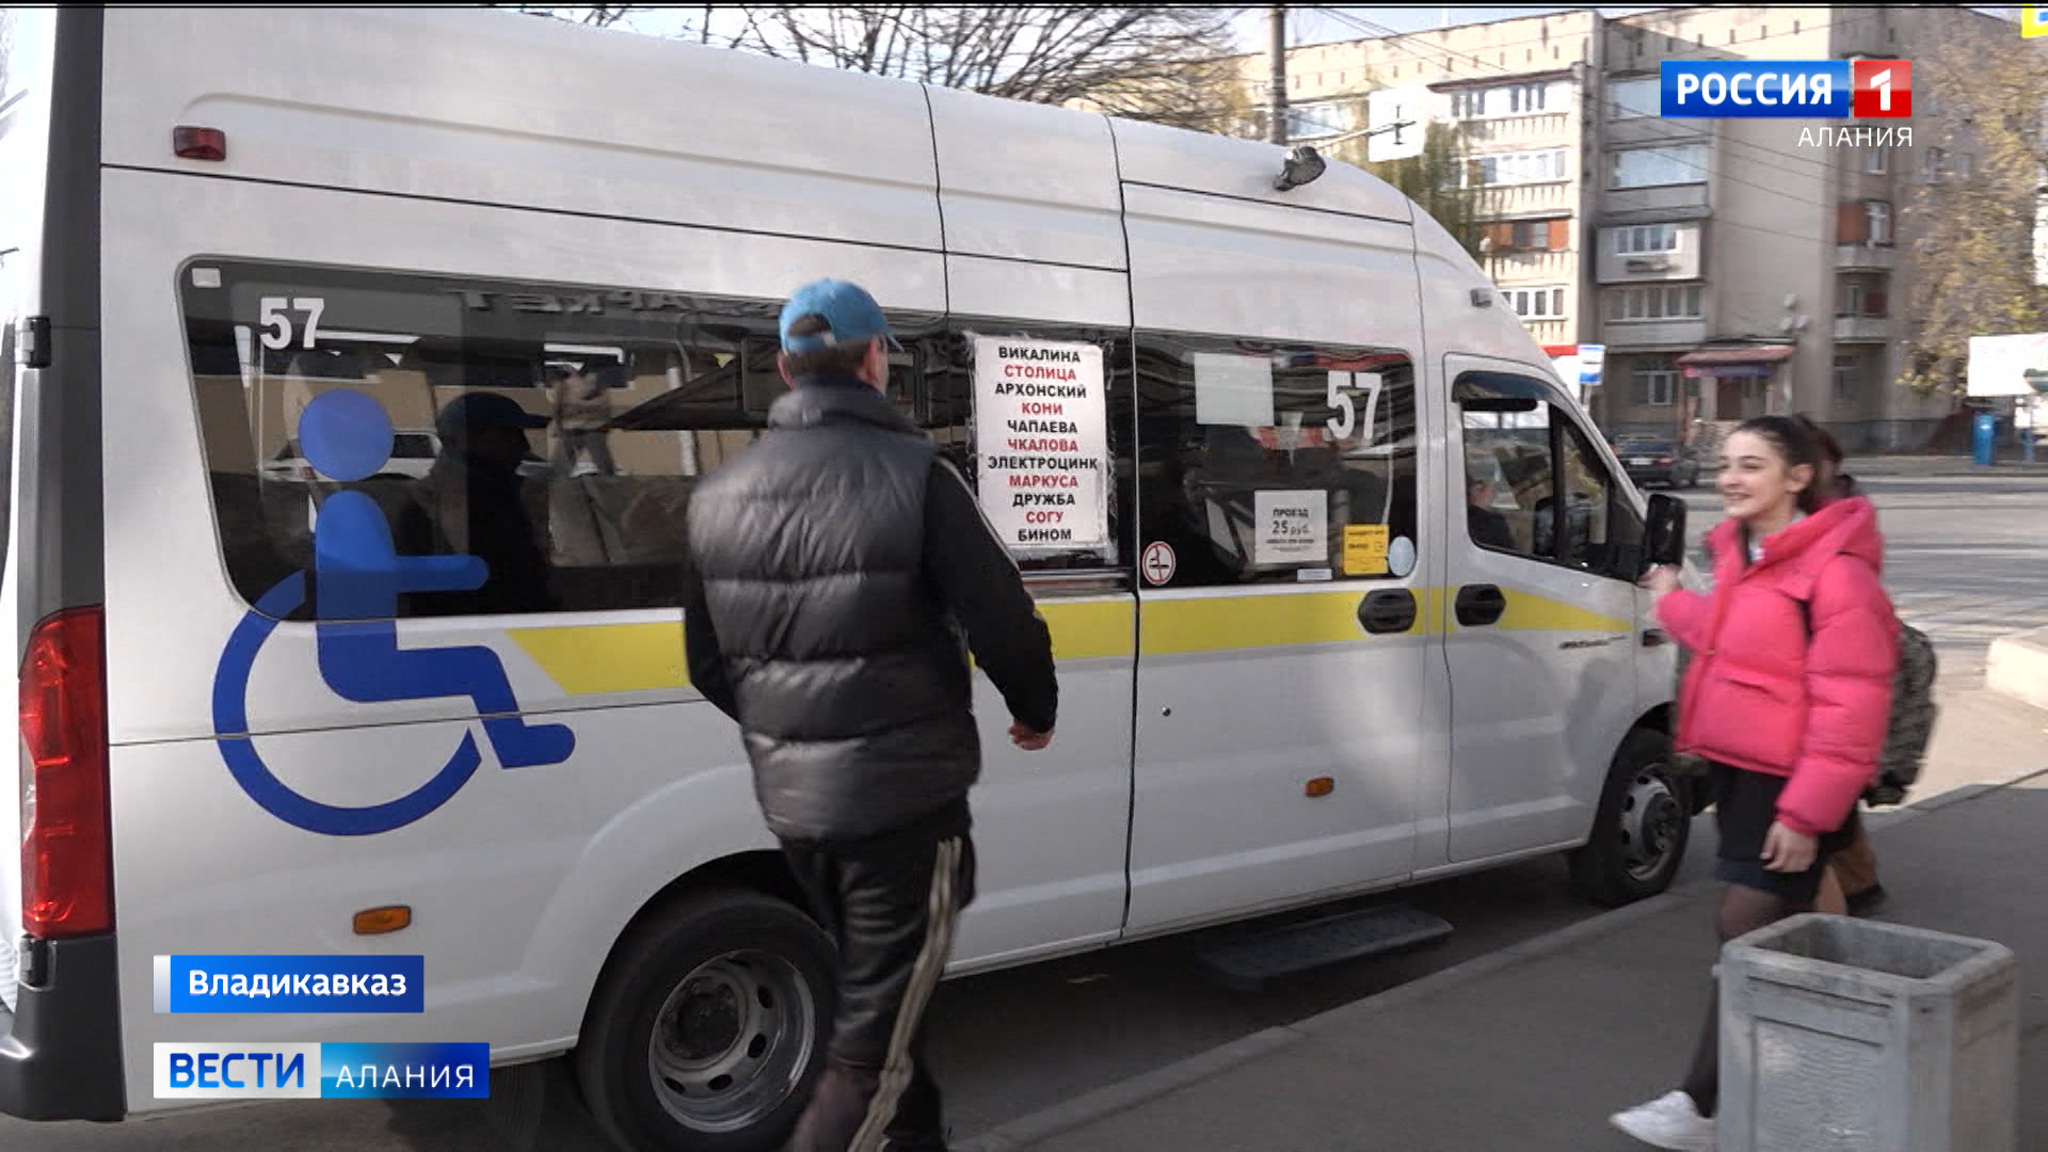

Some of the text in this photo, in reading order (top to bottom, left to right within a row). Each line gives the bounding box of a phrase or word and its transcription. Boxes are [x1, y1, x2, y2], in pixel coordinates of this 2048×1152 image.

[260, 297, 325, 350] 57
[998, 346, 1081, 362] ВИКАЛИНА
[1004, 364, 1076, 380] СТОЛИЦА
[995, 383, 1087, 398] АРХОНСКИЙ
[1021, 402, 1063, 414] КОНИ
[1326, 370, 1382, 440] 57
[1007, 419, 1078, 433] ЧАПАЕВА
[1007, 438, 1079, 451] ЧКАЛОВА
[988, 456, 1098, 470] ЭЛЕКТРОЦИНК
[1009, 475, 1078, 487] МАРКУСА
[1012, 493, 1076, 507] ДРУЖБА
[1026, 511, 1064, 524] СОГУ
[1272, 520, 1288, 534] 25
[1018, 528, 1072, 542] БИНОМ
